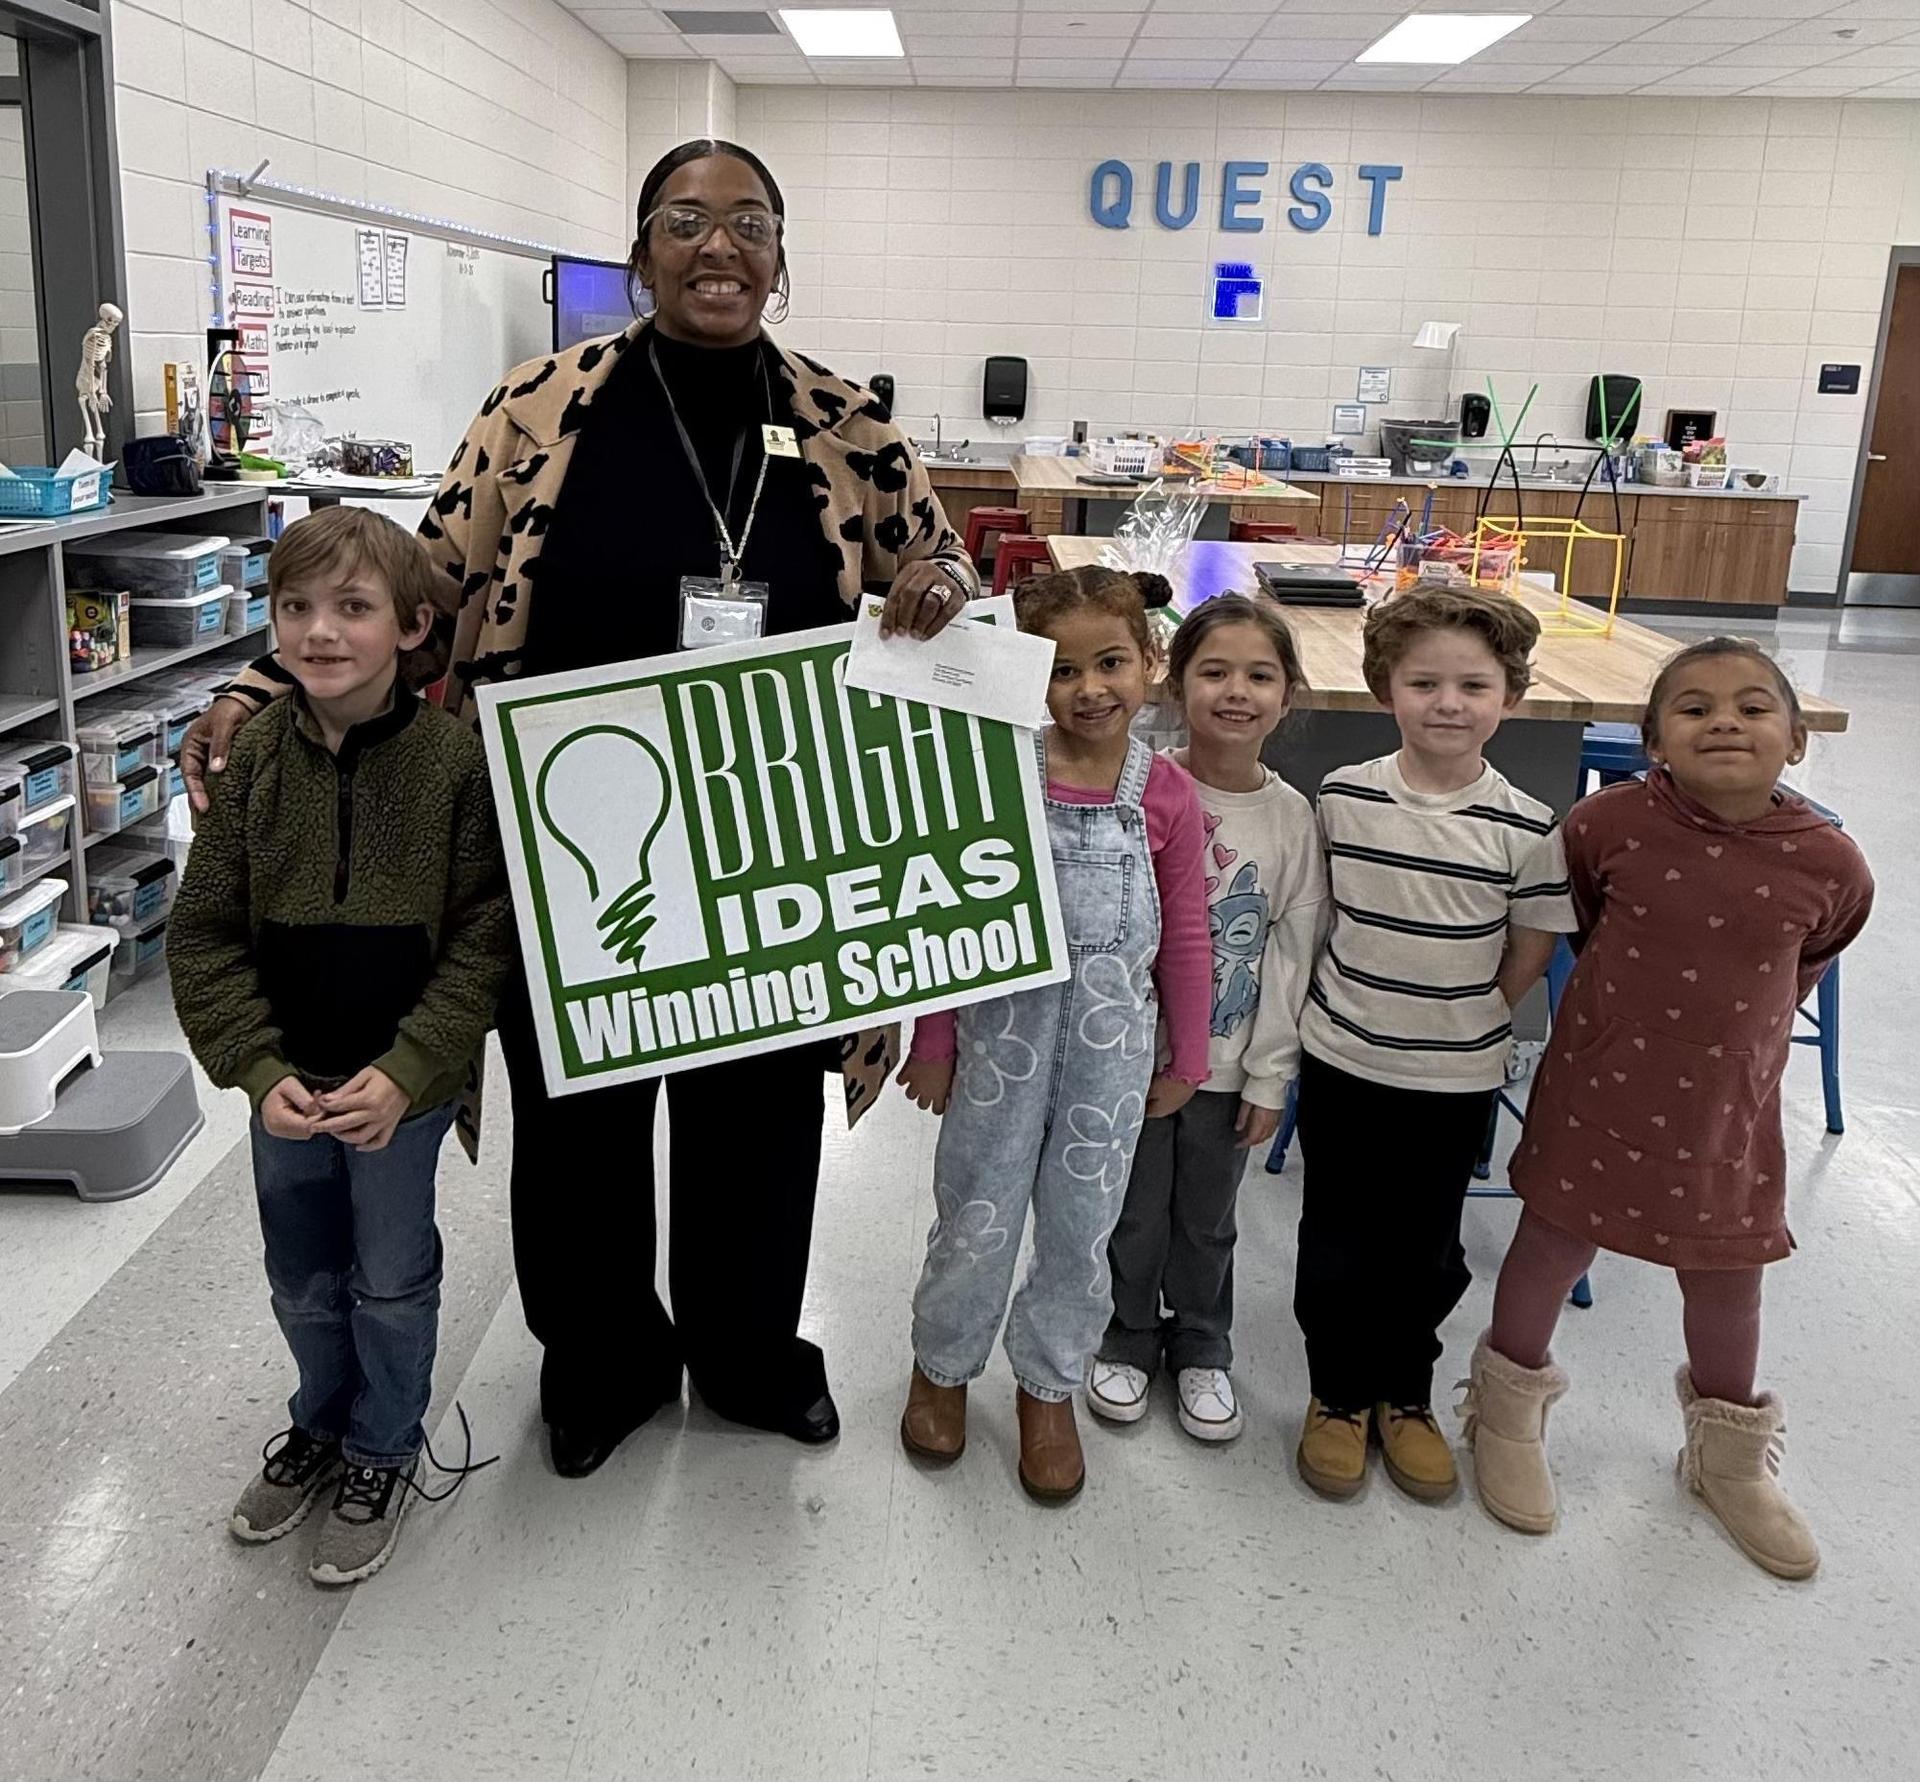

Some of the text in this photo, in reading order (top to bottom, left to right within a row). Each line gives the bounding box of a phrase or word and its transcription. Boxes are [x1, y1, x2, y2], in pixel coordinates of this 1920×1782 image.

[233, 220, 270, 246] Learning
[1090, 159, 1403, 236] QUEST
[677, 651, 996, 881] BRIGHT
[716, 838, 1021, 956] IDEAS
[565, 902, 1038, 1064] Winning School
